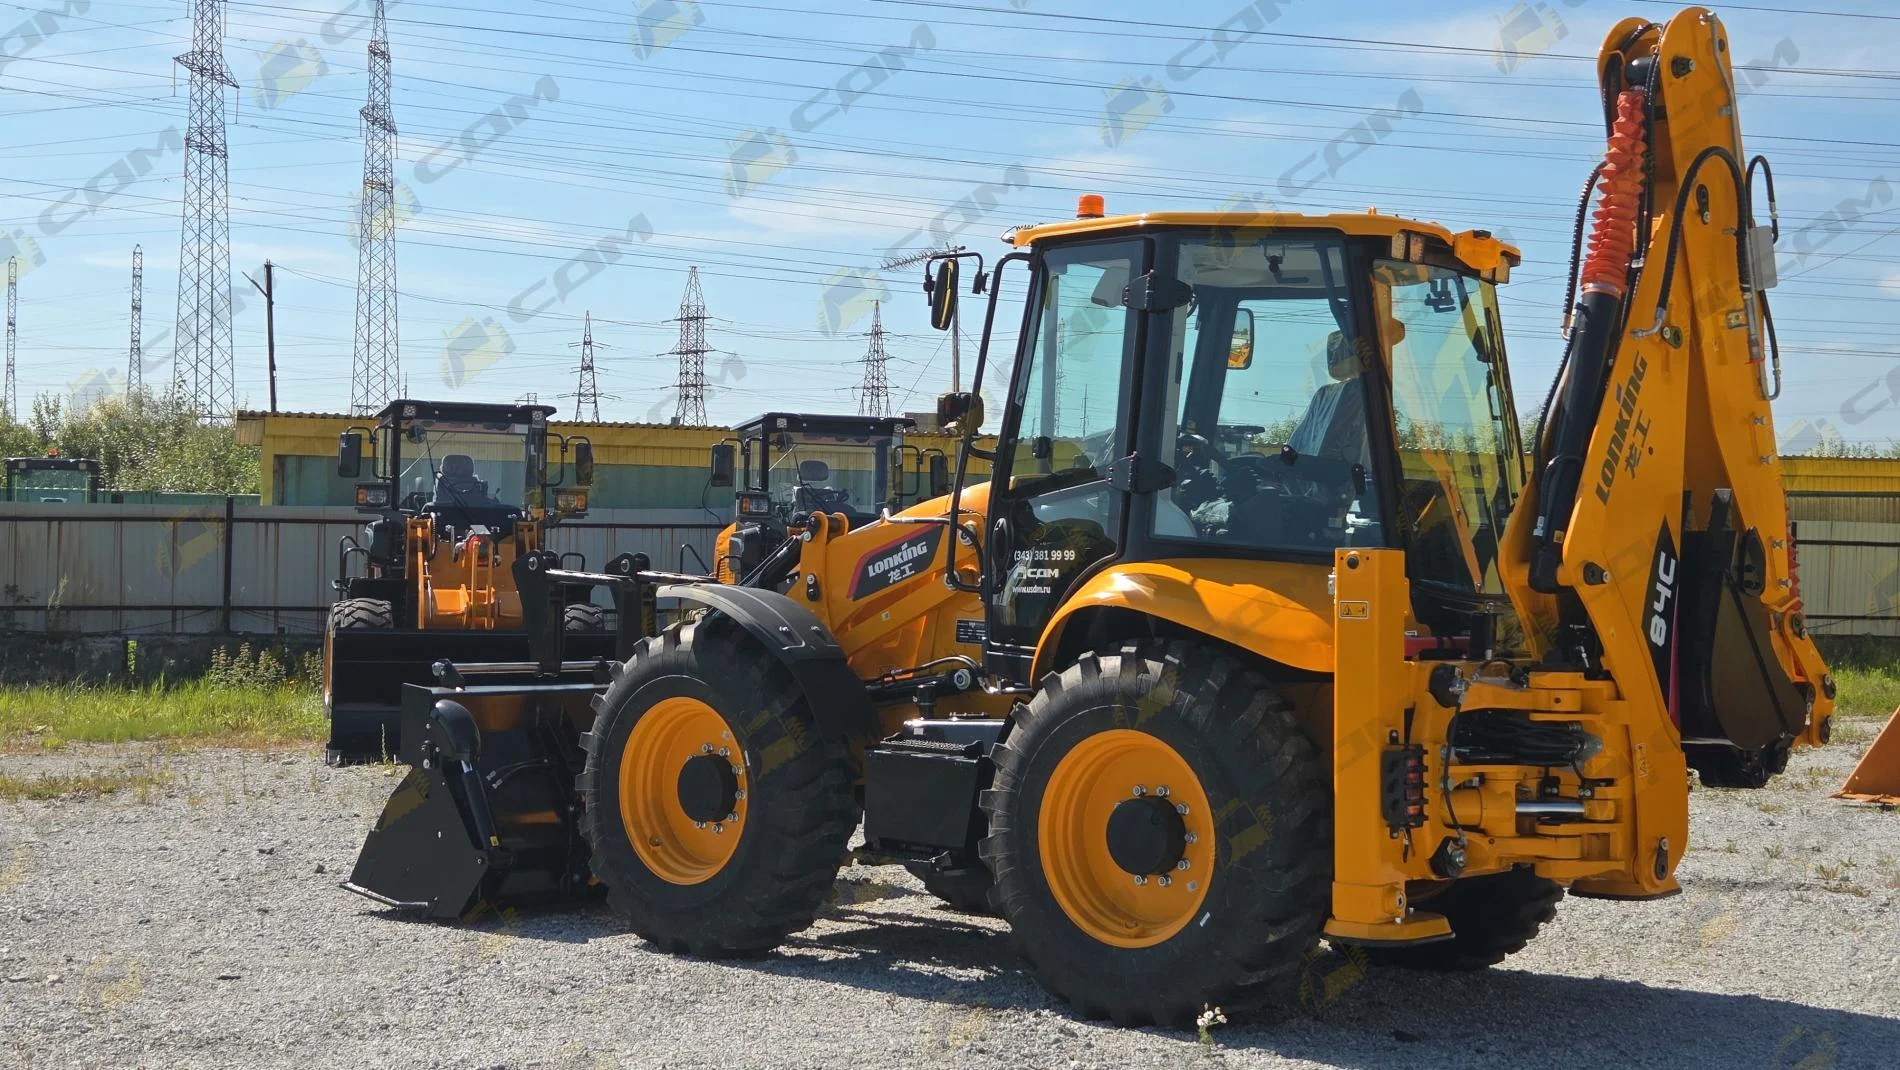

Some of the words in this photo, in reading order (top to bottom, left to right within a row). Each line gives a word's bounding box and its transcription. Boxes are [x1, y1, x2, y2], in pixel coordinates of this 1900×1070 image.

[1035, 550, 1049, 561] 381
[1051, 549, 1062, 561] 99
[1064, 549, 1076, 561] 99
[1013, 585, 1051, 594] www.usdm.ru
[1649, 551, 1676, 647] 84C
